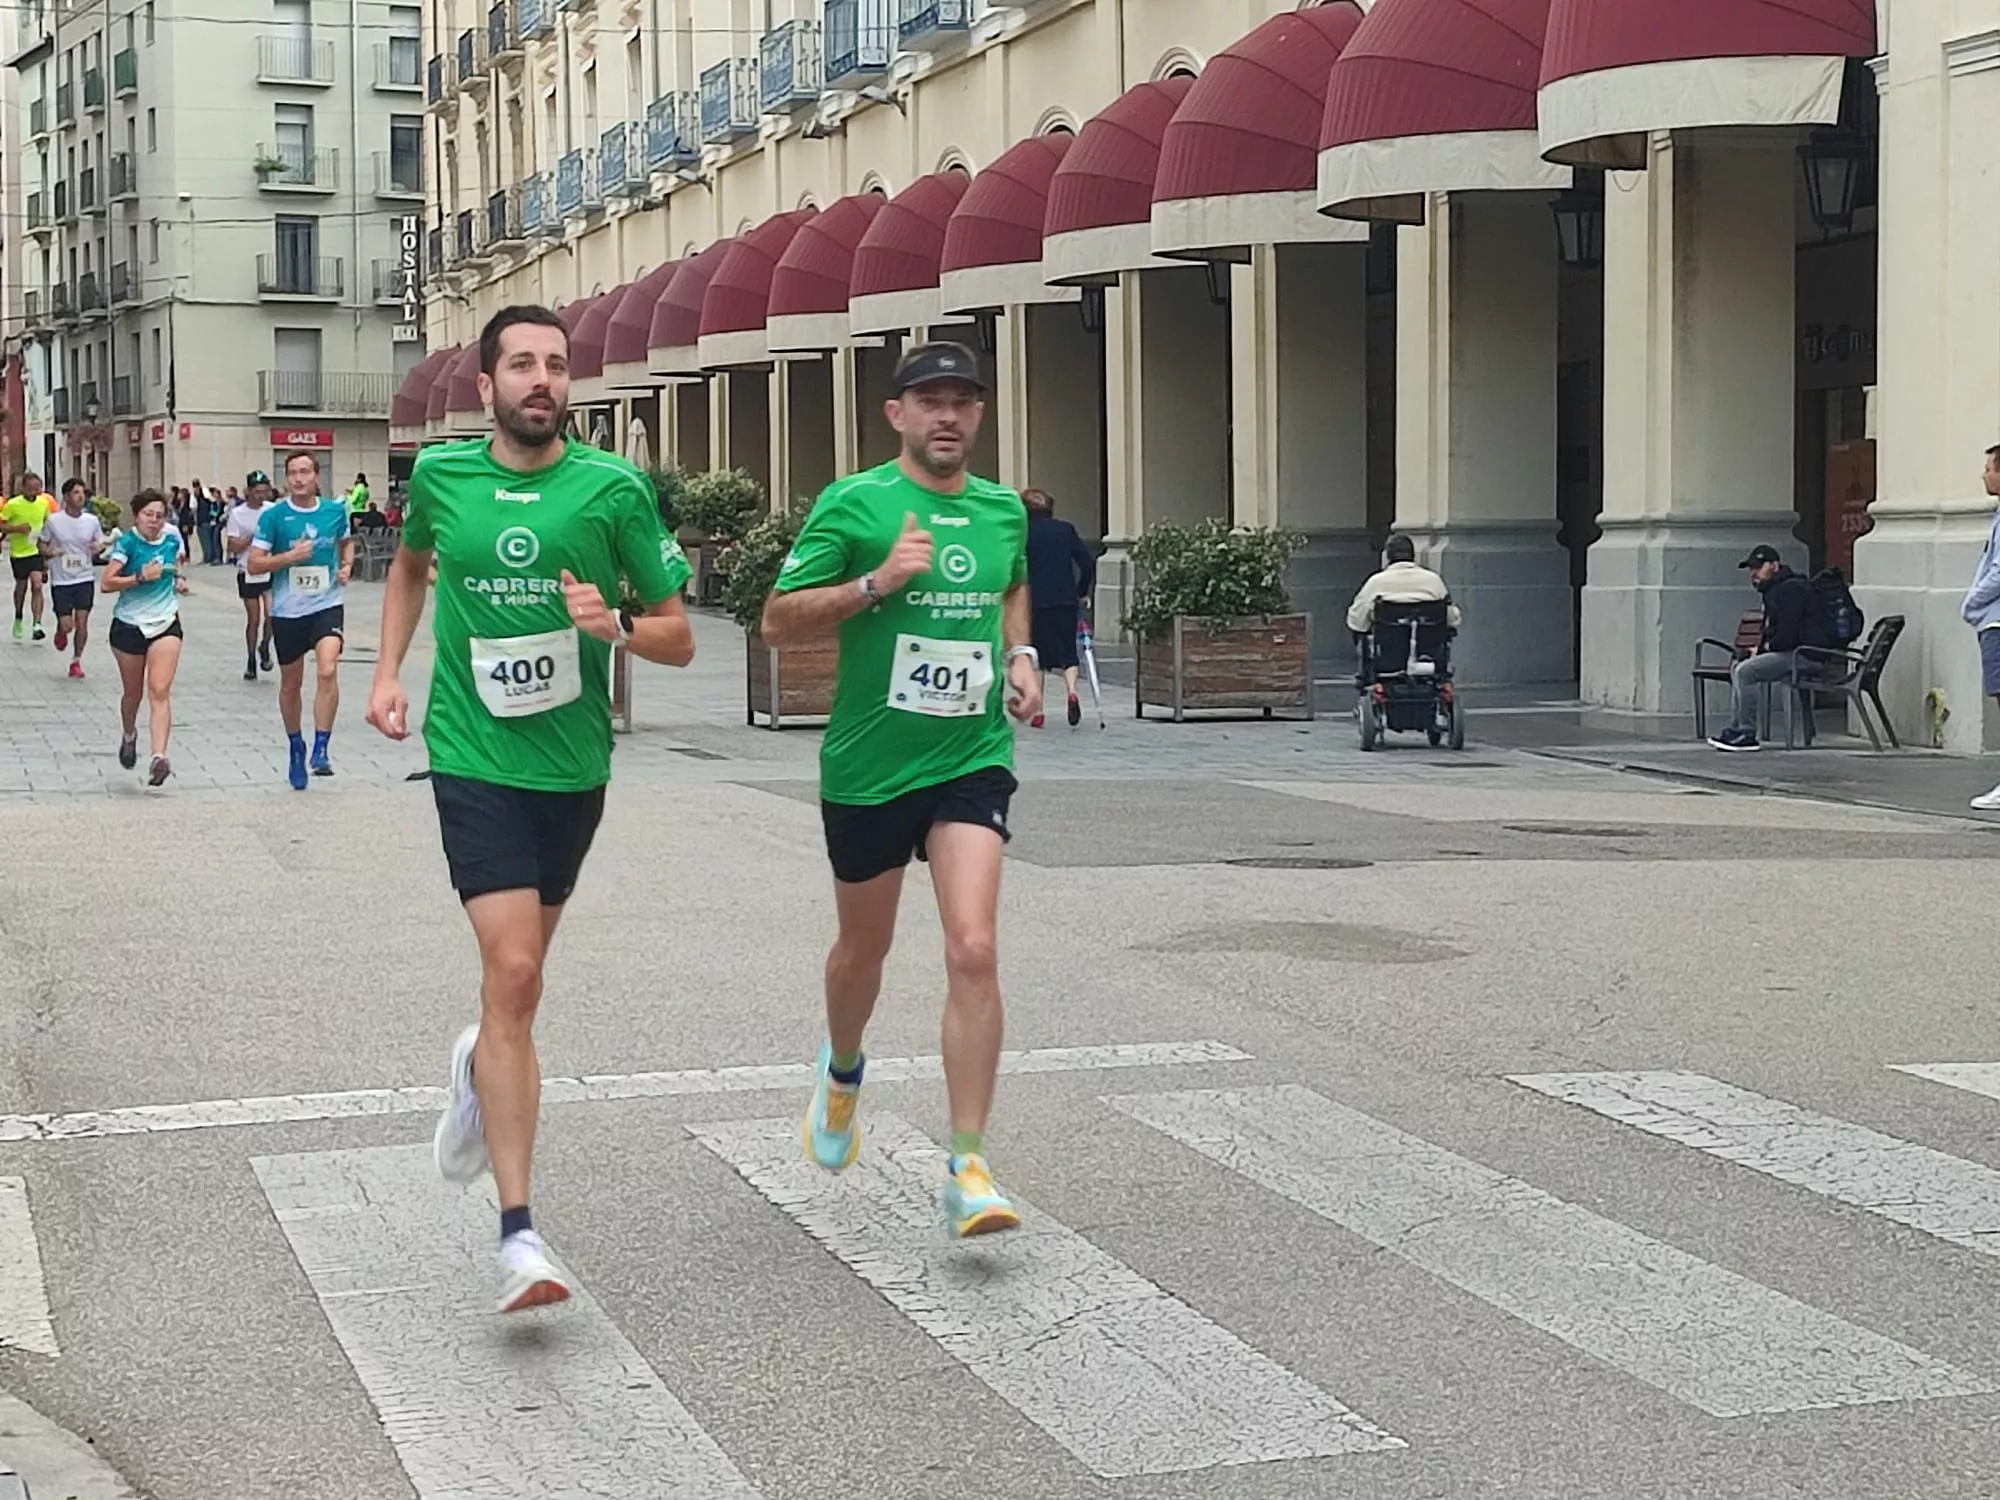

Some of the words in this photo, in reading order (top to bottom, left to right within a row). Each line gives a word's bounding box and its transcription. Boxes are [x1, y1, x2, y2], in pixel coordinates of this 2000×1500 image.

[402, 216, 416, 321] HOSTAL
[463, 576, 564, 593] CABRER
[490, 655, 554, 685] 400
[910, 663, 968, 691] 401
